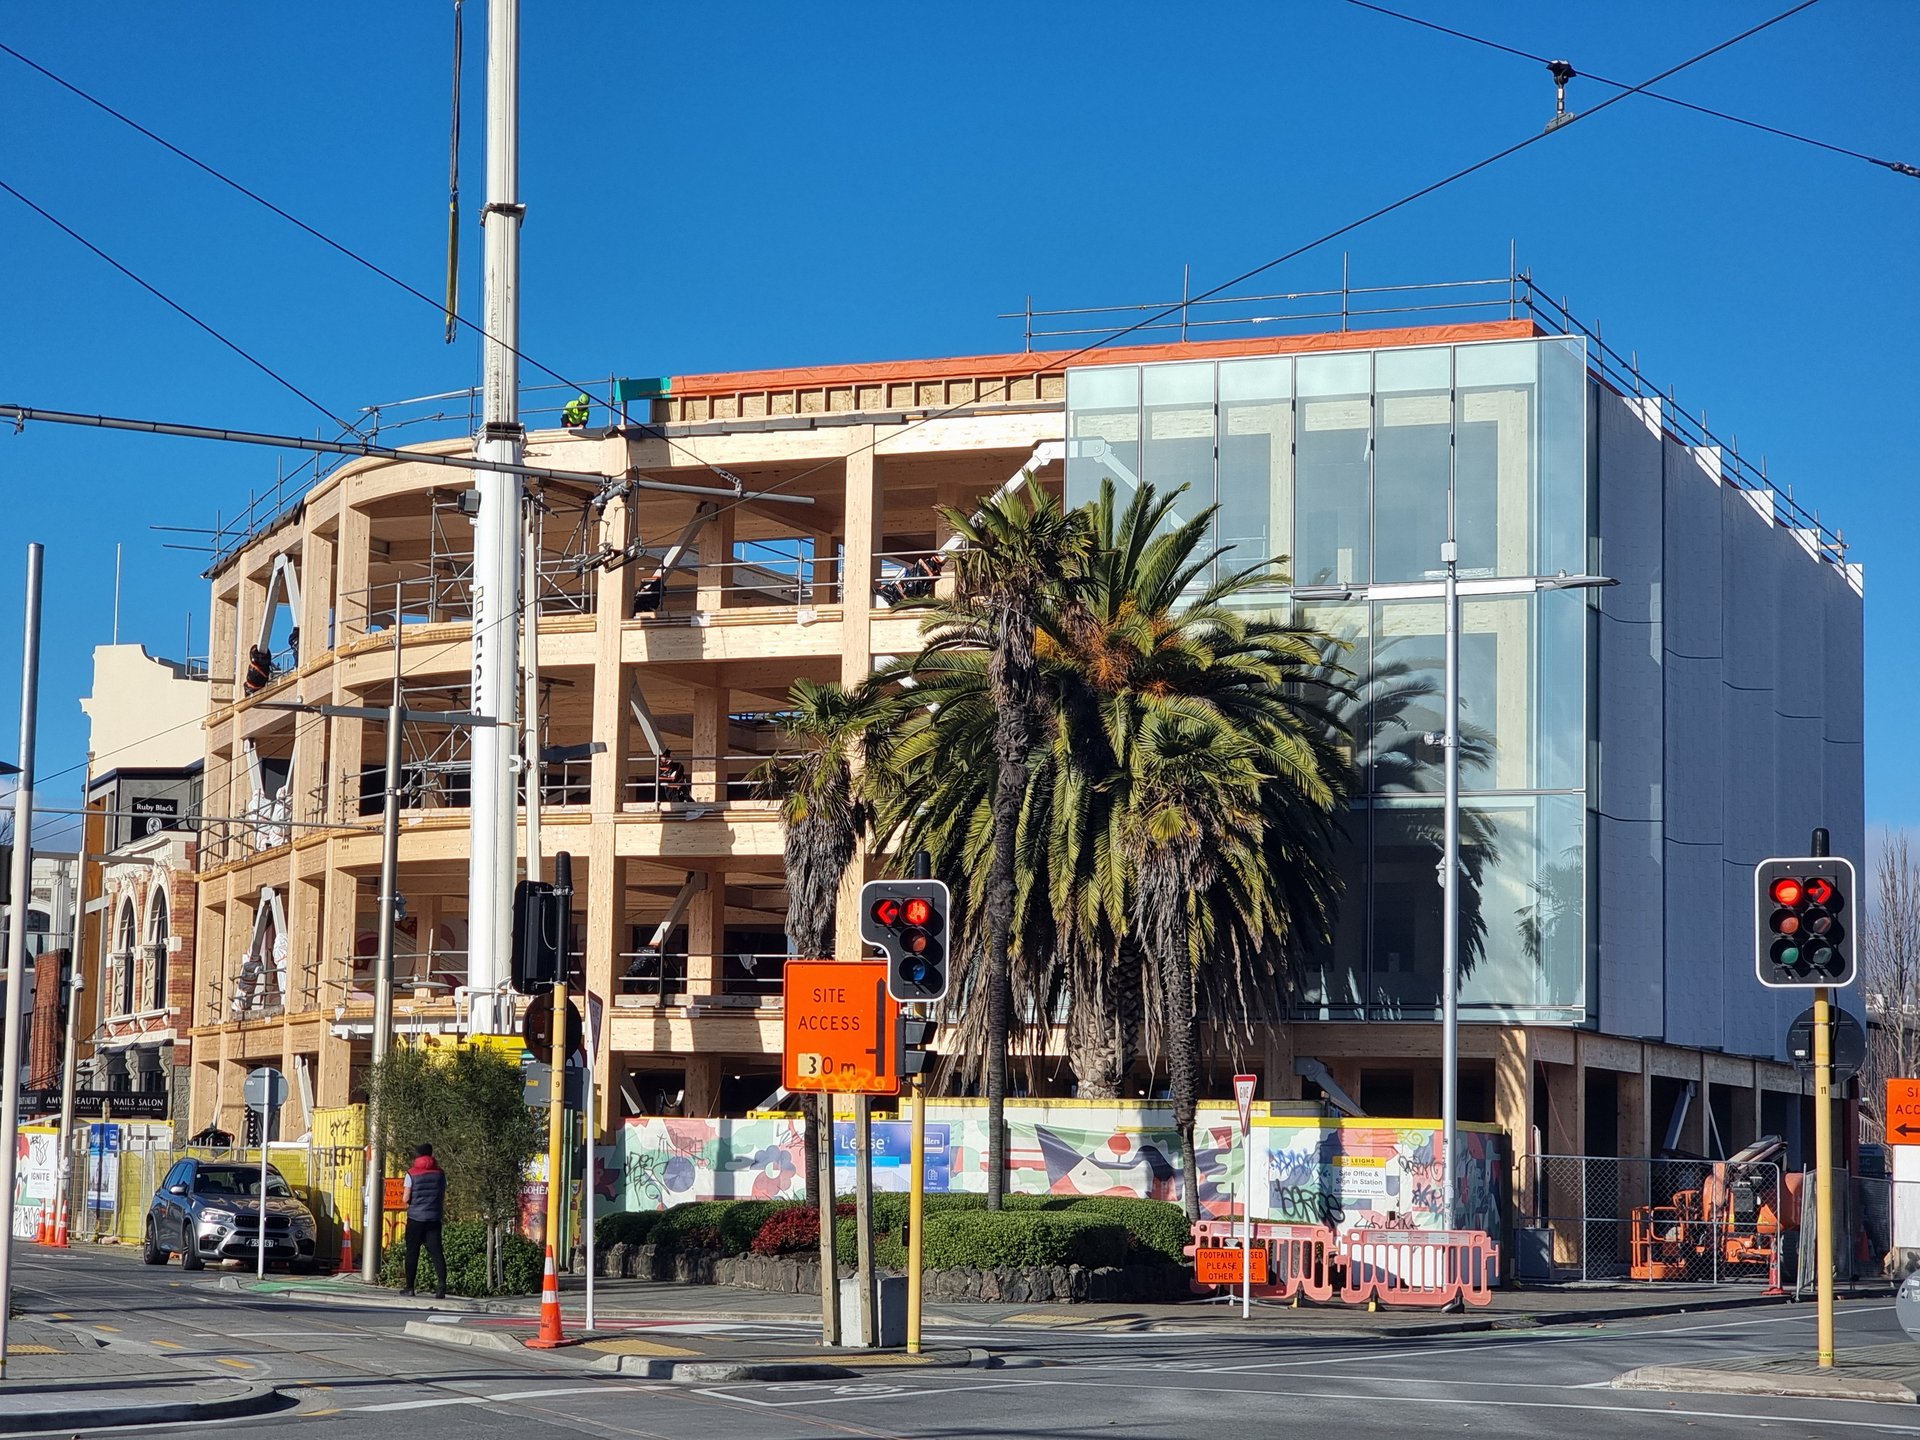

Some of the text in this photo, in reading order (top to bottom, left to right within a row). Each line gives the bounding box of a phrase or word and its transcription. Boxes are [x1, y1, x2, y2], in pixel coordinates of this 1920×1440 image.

[136, 804, 154, 812] Ruby
[813, 988, 846, 1003] SITE
[798, 1016, 860, 1031] ACCESS
[808, 1056, 856, 1075] 30 m
[1240, 1086, 1249, 1099] GIVE
[74, 1096, 101, 1105] EAUTY
[113, 1098, 135, 1106] NAILS
[138, 1098, 164, 1106] SALON
[841, 1134, 885, 1150] Lese
[31, 1172, 50, 1181] IGNITE
[1335, 1178, 1350, 1186] Sign
[1360, 1178, 1383, 1186] Station
[1207, 1262, 1237, 1270] PLEASE
